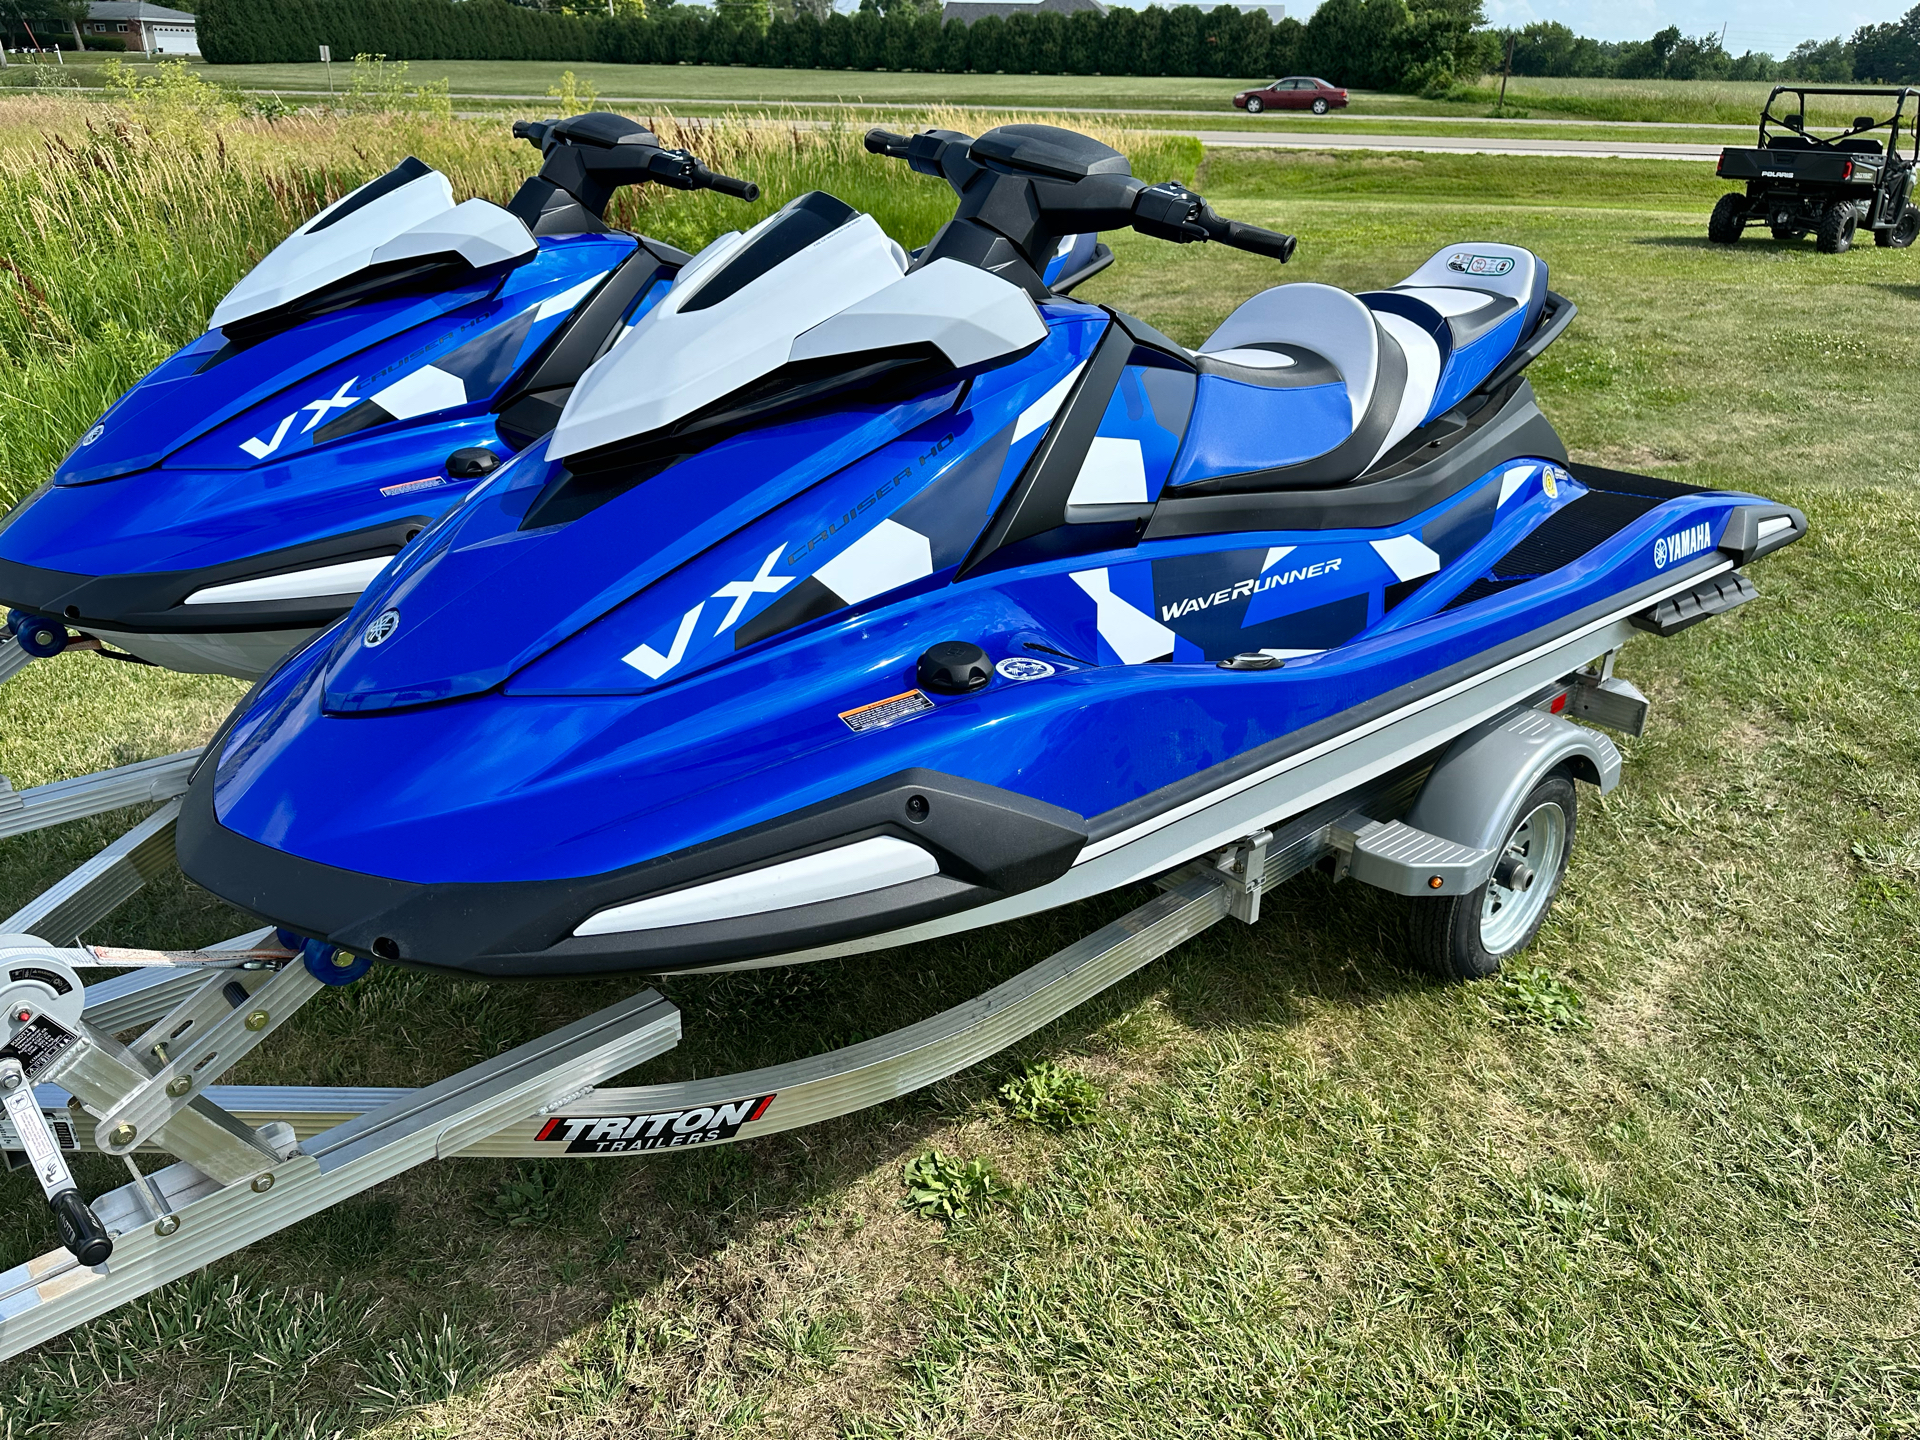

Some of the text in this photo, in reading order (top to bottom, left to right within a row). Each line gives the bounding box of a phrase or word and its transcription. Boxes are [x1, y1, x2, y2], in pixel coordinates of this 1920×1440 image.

[239, 311, 491, 460] VX CRUISER HO
[621, 432, 956, 680] VX CRUISER HO
[1667, 521, 1711, 563] YAMAHA
[10, 1029, 29, 1045] KNOTT
[562, 1098, 756, 1140] TRITON
[596, 1130, 720, 1152] TRAILERS
